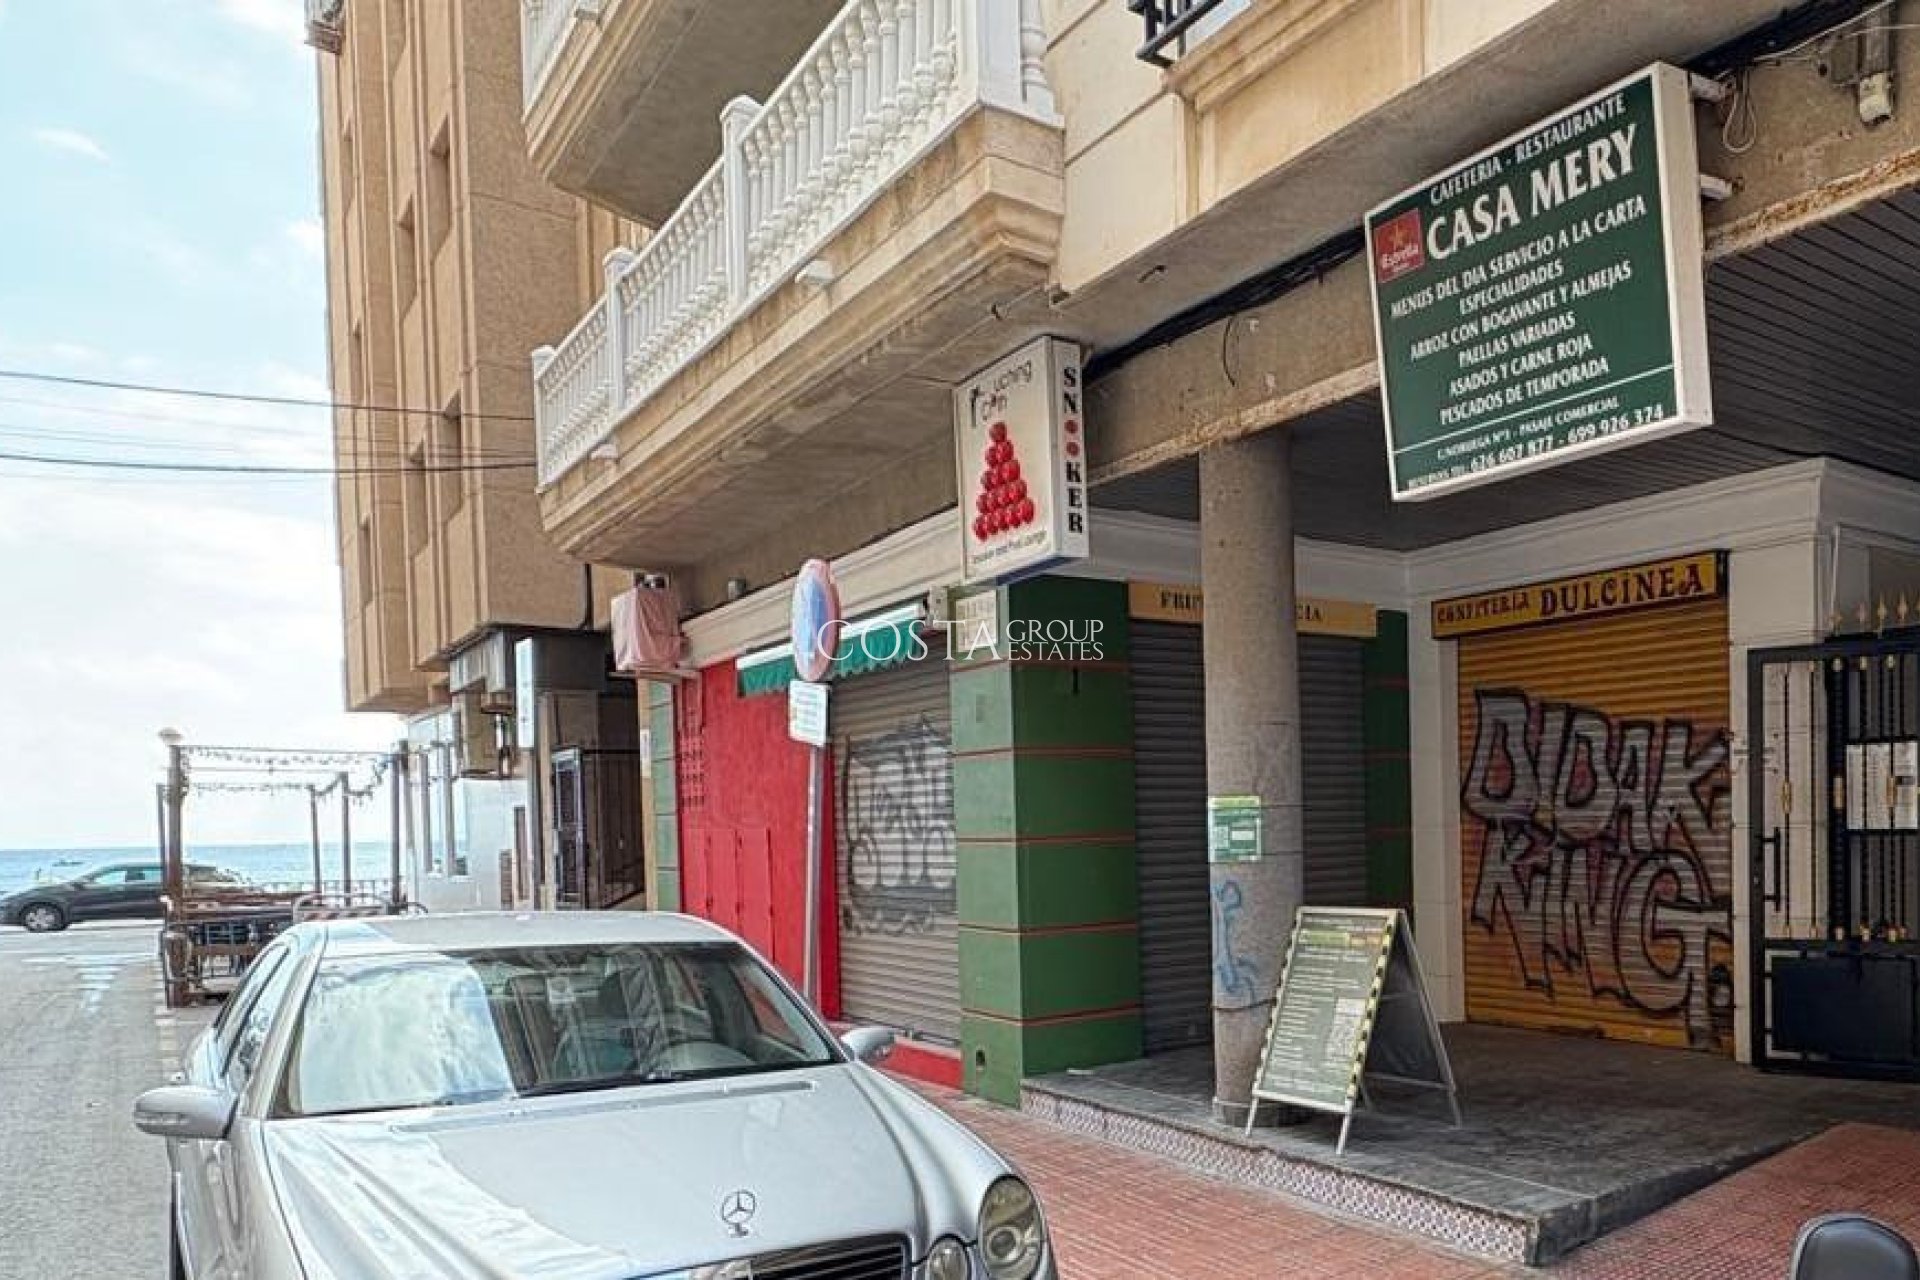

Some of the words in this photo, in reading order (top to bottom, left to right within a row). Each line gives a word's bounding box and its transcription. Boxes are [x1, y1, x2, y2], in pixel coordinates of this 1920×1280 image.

[1514, 92, 1626, 164] RESTAURANTE
[1426, 184, 1521, 260] CASA
[1530, 123, 1637, 217] MERY
[1436, 275, 1461, 300] DEL
[1489, 235, 1554, 275] SERVICIO
[1558, 229, 1569, 249] A
[1572, 218, 1591, 244] LA
[1594, 194, 1648, 233] CARTA
[1450, 320, 1478, 346] CON
[1481, 289, 1557, 334] BOGAVANTE
[1559, 284, 1568, 304] Y
[1571, 260, 1632, 300] ALMEJAS
[1459, 257, 1564, 315] ESPECIALIDADES
[1449, 366, 1499, 398] ASADOS
[1499, 362, 1508, 379] Y
[1510, 346, 1555, 376] CARNE
[1556, 333, 1594, 360] ROJA
[1505, 383, 1524, 405] DE
[1525, 355, 1611, 398] TEMPORADA
[1540, 563, 1705, 616] DULCINEA
